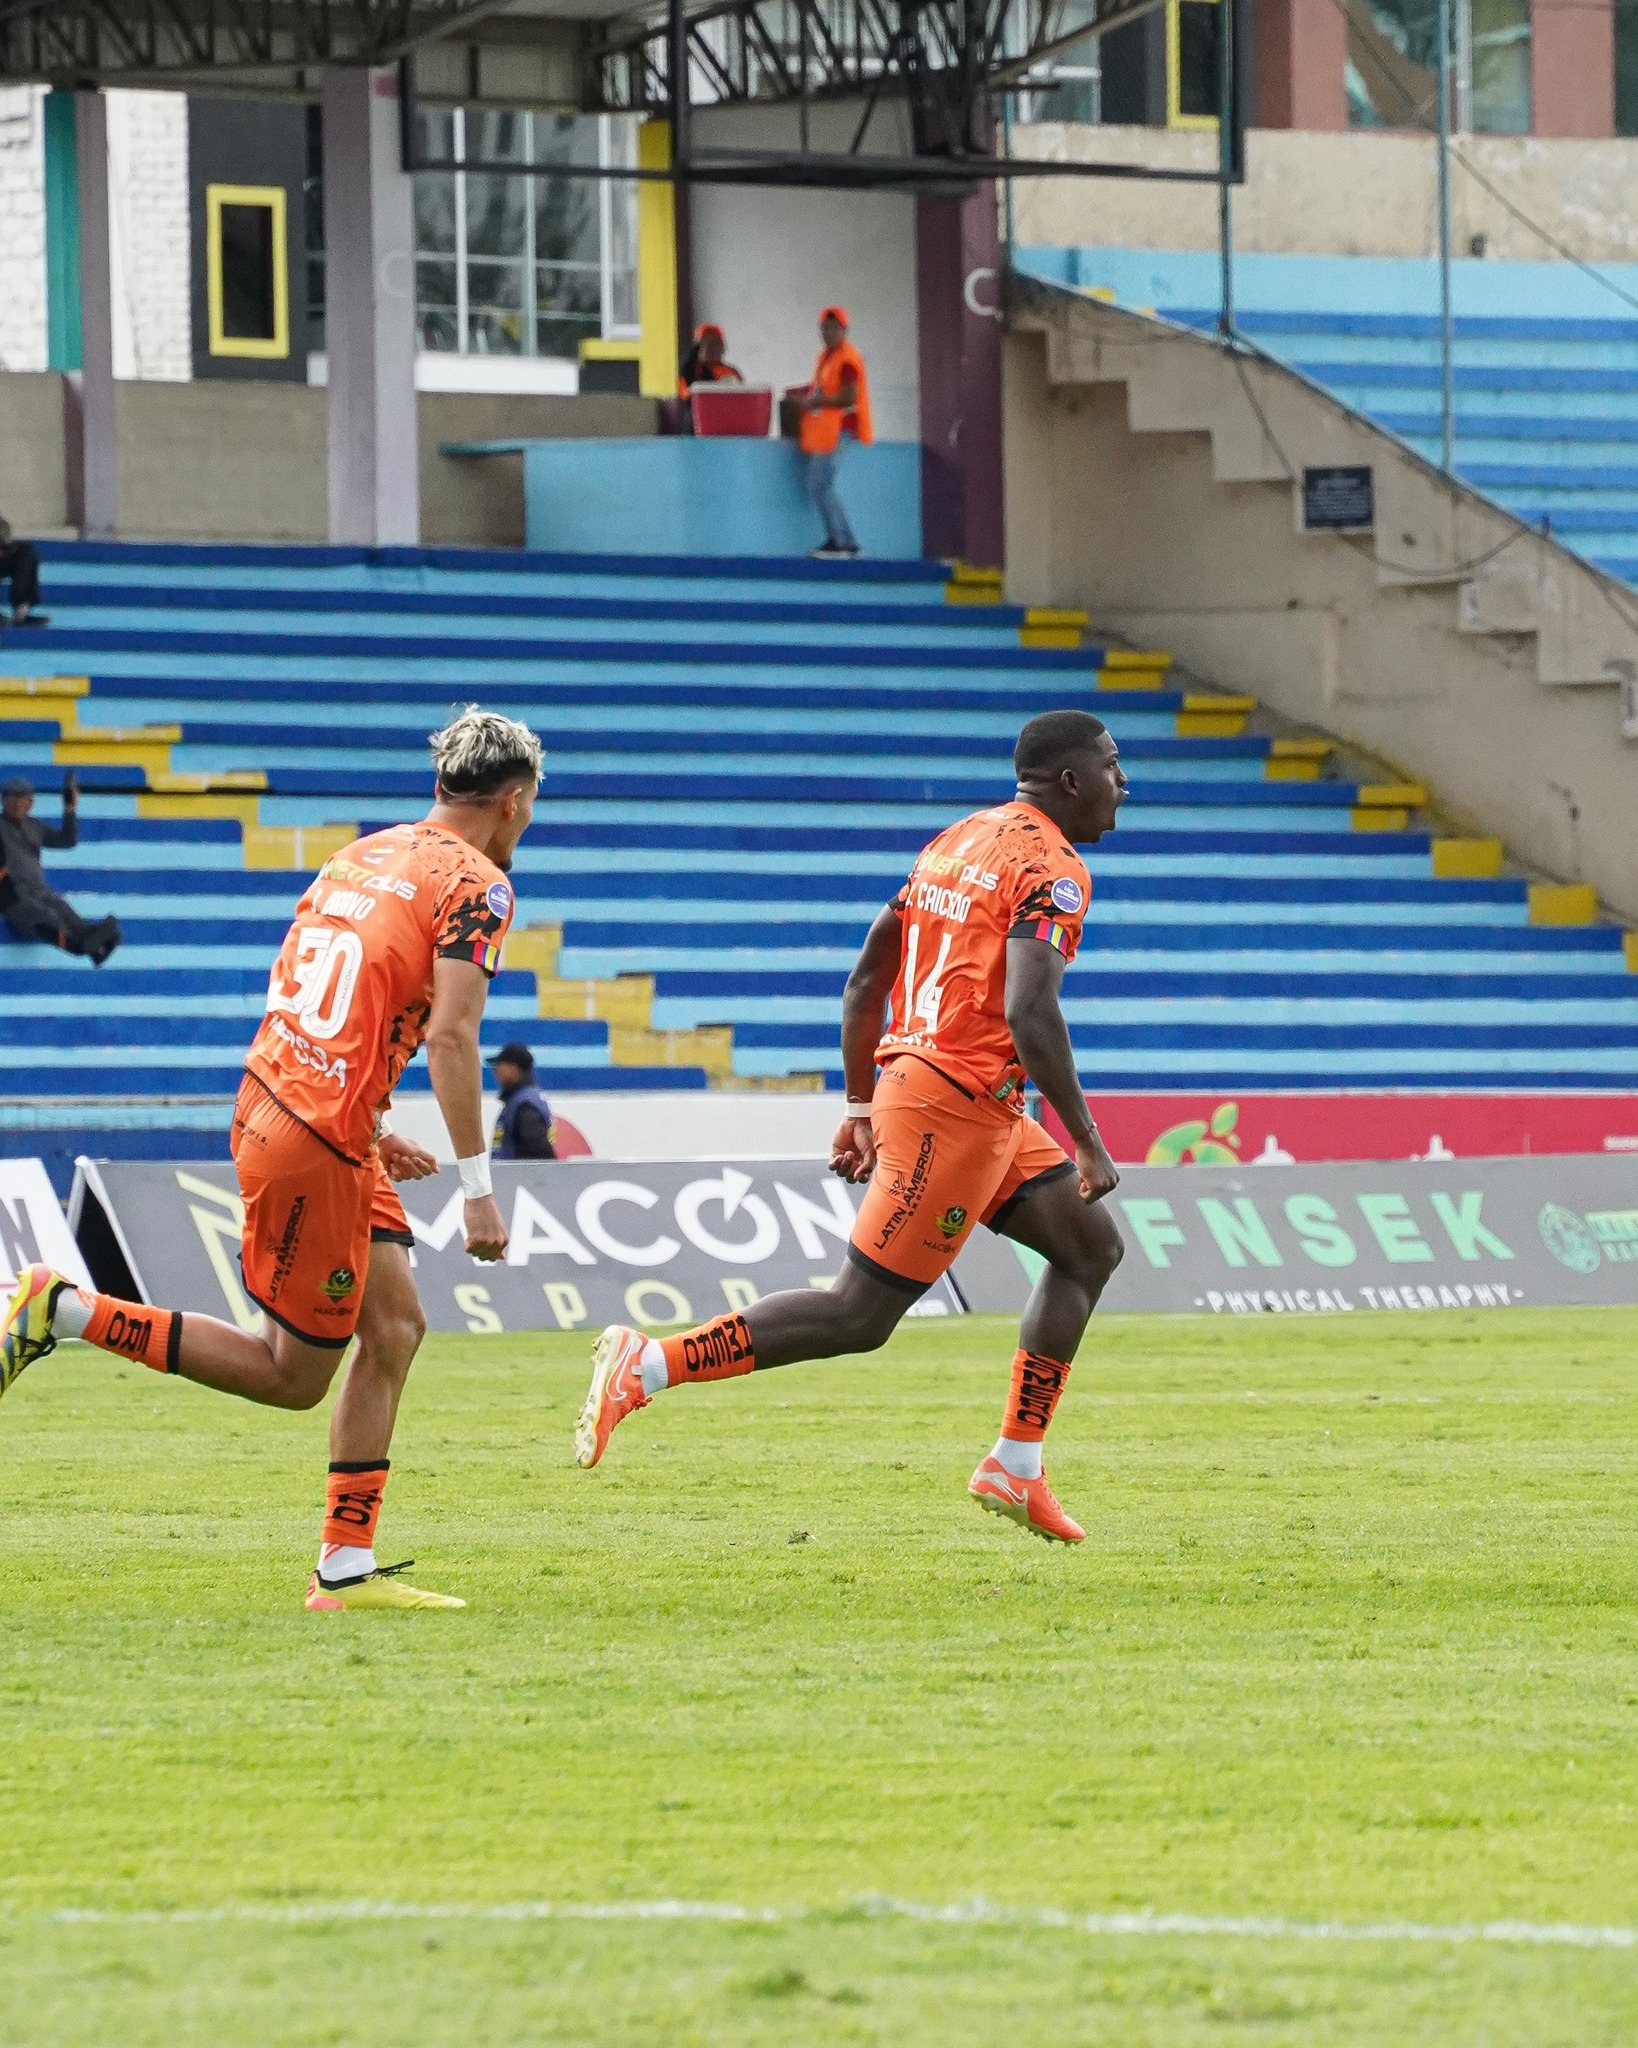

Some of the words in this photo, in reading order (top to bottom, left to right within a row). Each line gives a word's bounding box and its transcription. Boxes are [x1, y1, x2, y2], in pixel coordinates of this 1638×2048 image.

[320, 890, 376, 921] BRAVO
[266, 927, 363, 1040] 30
[904, 923, 953, 1034] 14
[874, 1206, 907, 1250] LATIN
[902, 1132, 934, 1206] AMERICA
[266, 1263, 283, 1303] LATIN
[276, 1195, 306, 1264] AMERICA
